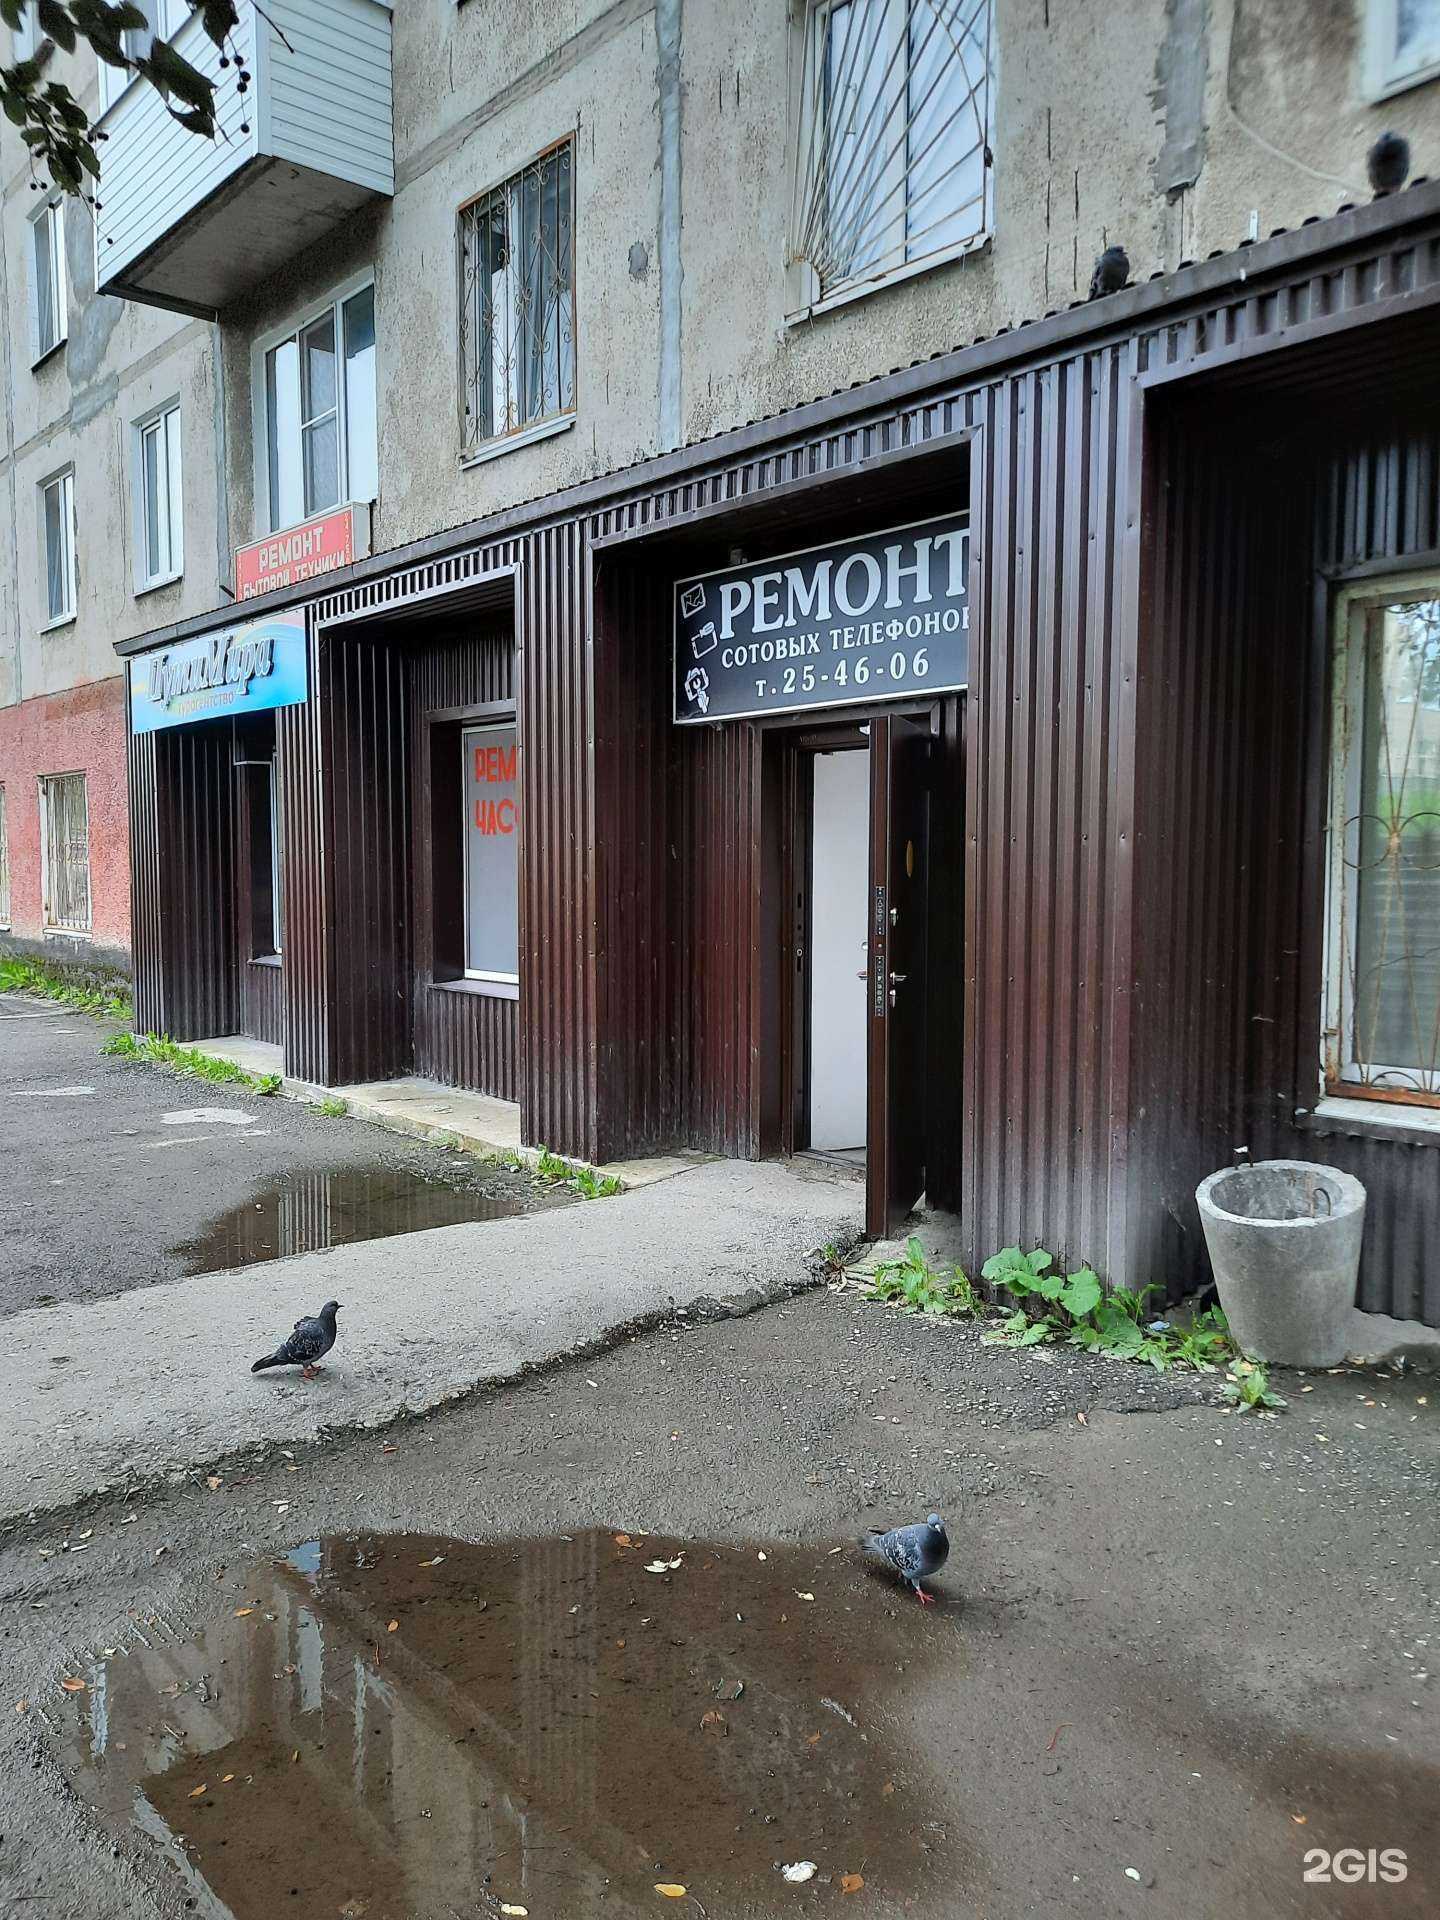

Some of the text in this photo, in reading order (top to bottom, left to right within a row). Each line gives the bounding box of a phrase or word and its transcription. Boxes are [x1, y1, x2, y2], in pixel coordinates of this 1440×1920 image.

[258, 526, 324, 573] РЕМОНТ
[294, 550, 346, 581] ТЕХНИКИ
[719, 528, 970, 640] РЕМОНТ
[721, 632, 821, 670] СОТОВЫХ
[474, 745, 518, 784] РЕМ
[474, 798, 519, 836] ЧАС
